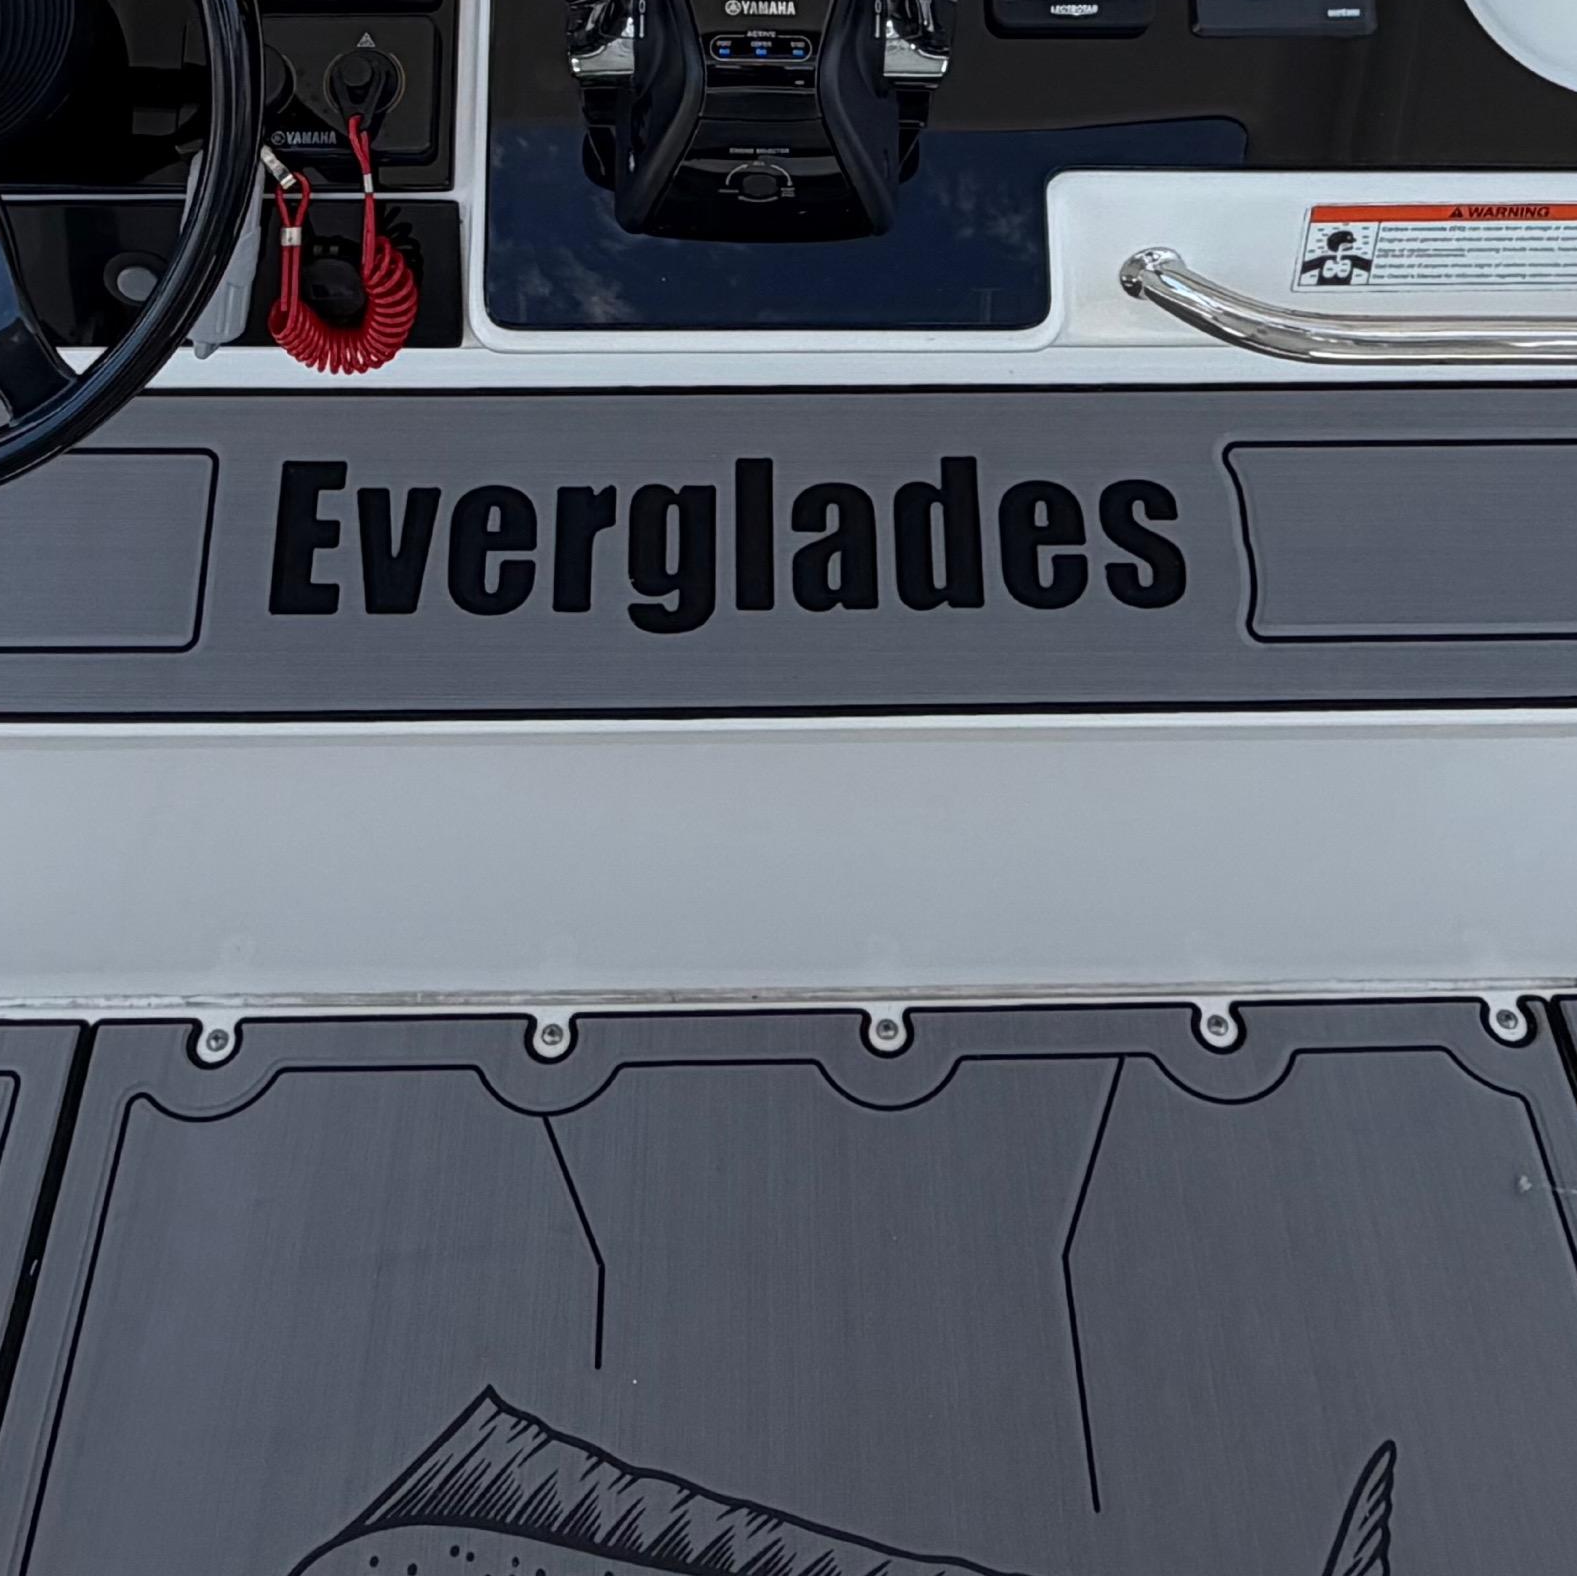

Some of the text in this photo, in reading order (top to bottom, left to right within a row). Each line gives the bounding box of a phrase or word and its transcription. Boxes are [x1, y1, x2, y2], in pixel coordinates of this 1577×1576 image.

[741, 0, 796, 15] YAMAHA
[286, 131, 337, 145] YAMAHA
[1468, 206, 1550, 218] WARNING
[268, 456, 1187, 634] Everglades
